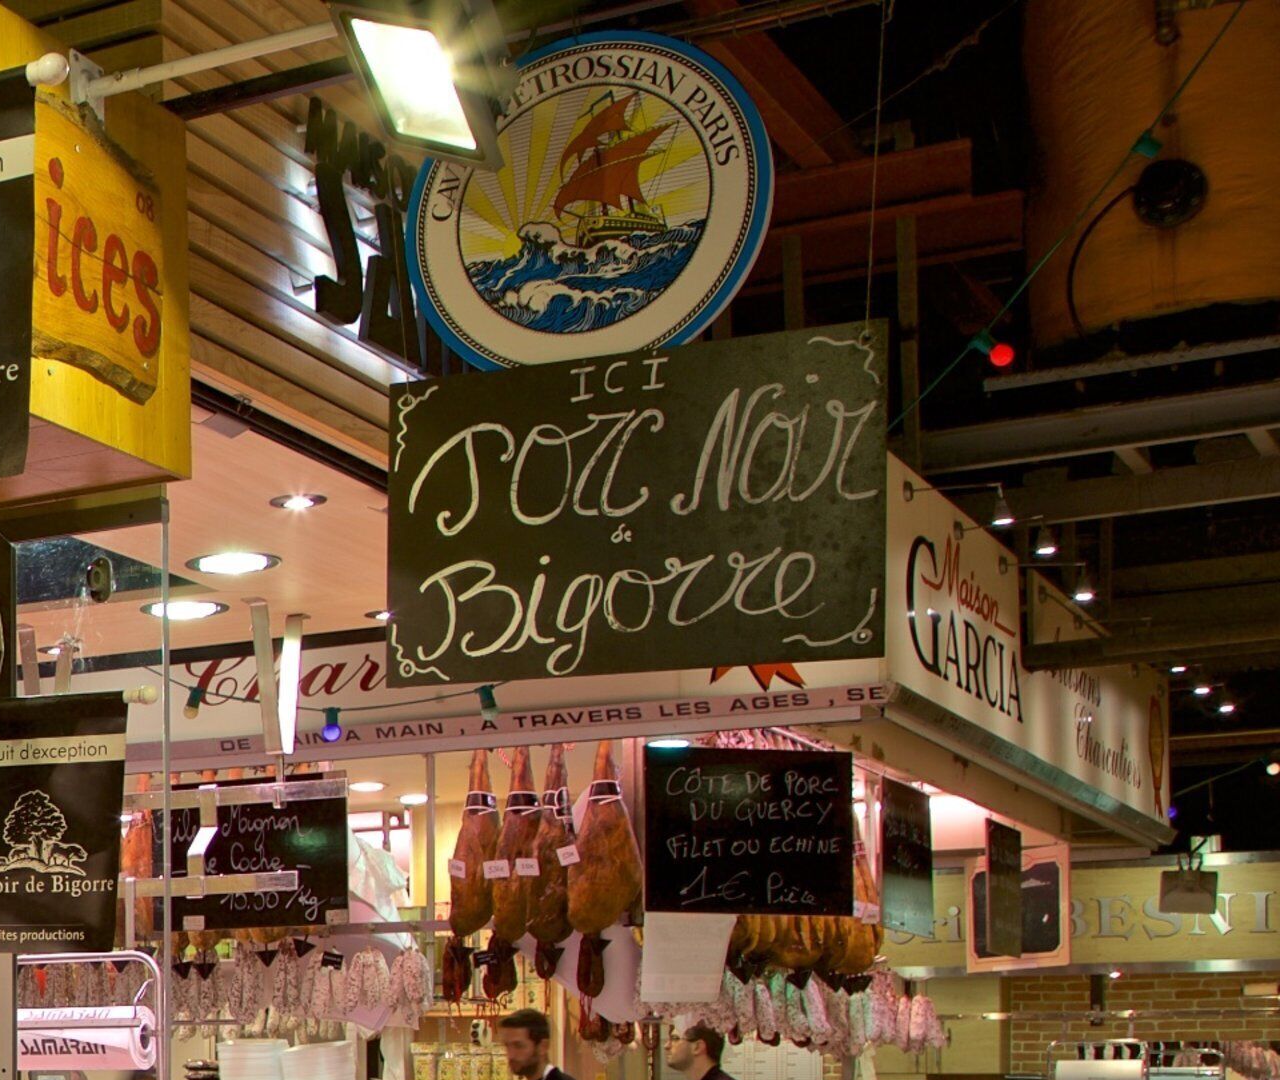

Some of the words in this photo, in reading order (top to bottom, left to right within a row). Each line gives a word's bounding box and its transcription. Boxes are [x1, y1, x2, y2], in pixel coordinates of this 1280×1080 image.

[681, 85, 740, 168] PARIS
[570, 354, 669, 402] ICI
[670, 374, 879, 517] Noir
[611, 522, 632, 544] de
[921, 535, 1016, 637] Maison
[417, 546, 825, 675] Bigorre
[906, 536, 1024, 724] GARCIA
[220, 738, 252, 753] DE
[376, 721, 444, 740] MAIN
[513, 706, 643, 729] TRAVERS
[659, 701, 710, 717] LES
[730, 693, 810, 711] AGES
[19, 742, 109, 762] d'exception
[747, 770, 776, 793] DE
[785, 771, 839, 795] PORC
[690, 800, 728, 823] DU
[735, 801, 834, 825] QUERCY
[731, 836, 760, 856] OU
[26, 877, 45, 894] de
[51, 875, 114, 898] Bigorre
[19, 930, 85, 944] productions
